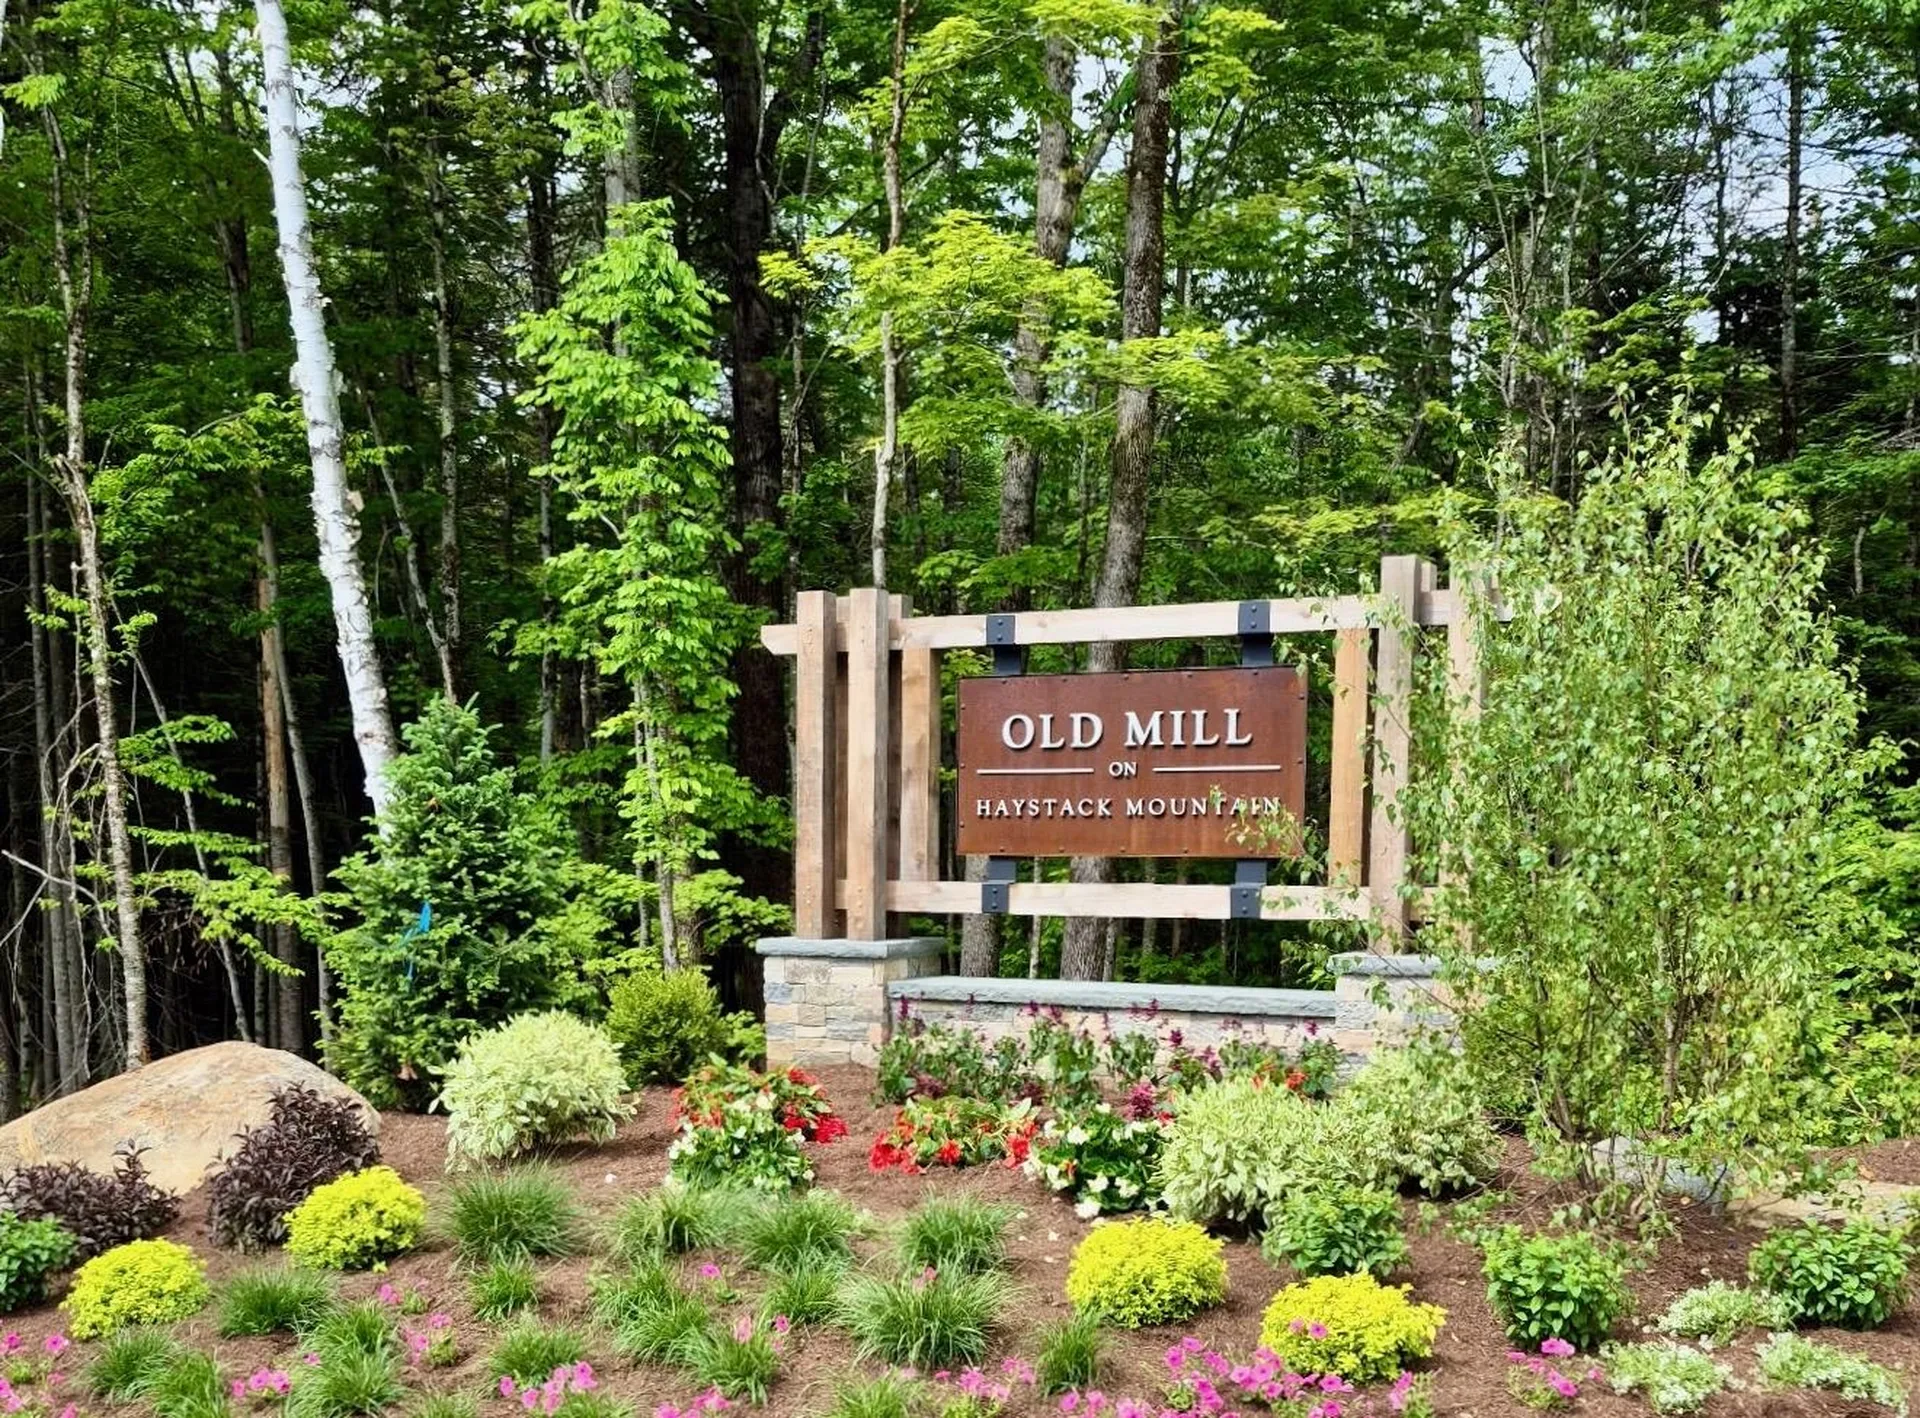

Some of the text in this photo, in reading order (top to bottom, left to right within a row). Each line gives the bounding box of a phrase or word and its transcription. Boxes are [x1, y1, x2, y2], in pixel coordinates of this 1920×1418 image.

[1001, 708, 1253, 749] OLD MILL
[1109, 761, 1137, 777] ON
[976, 798, 1112, 816] HAYSTACK
